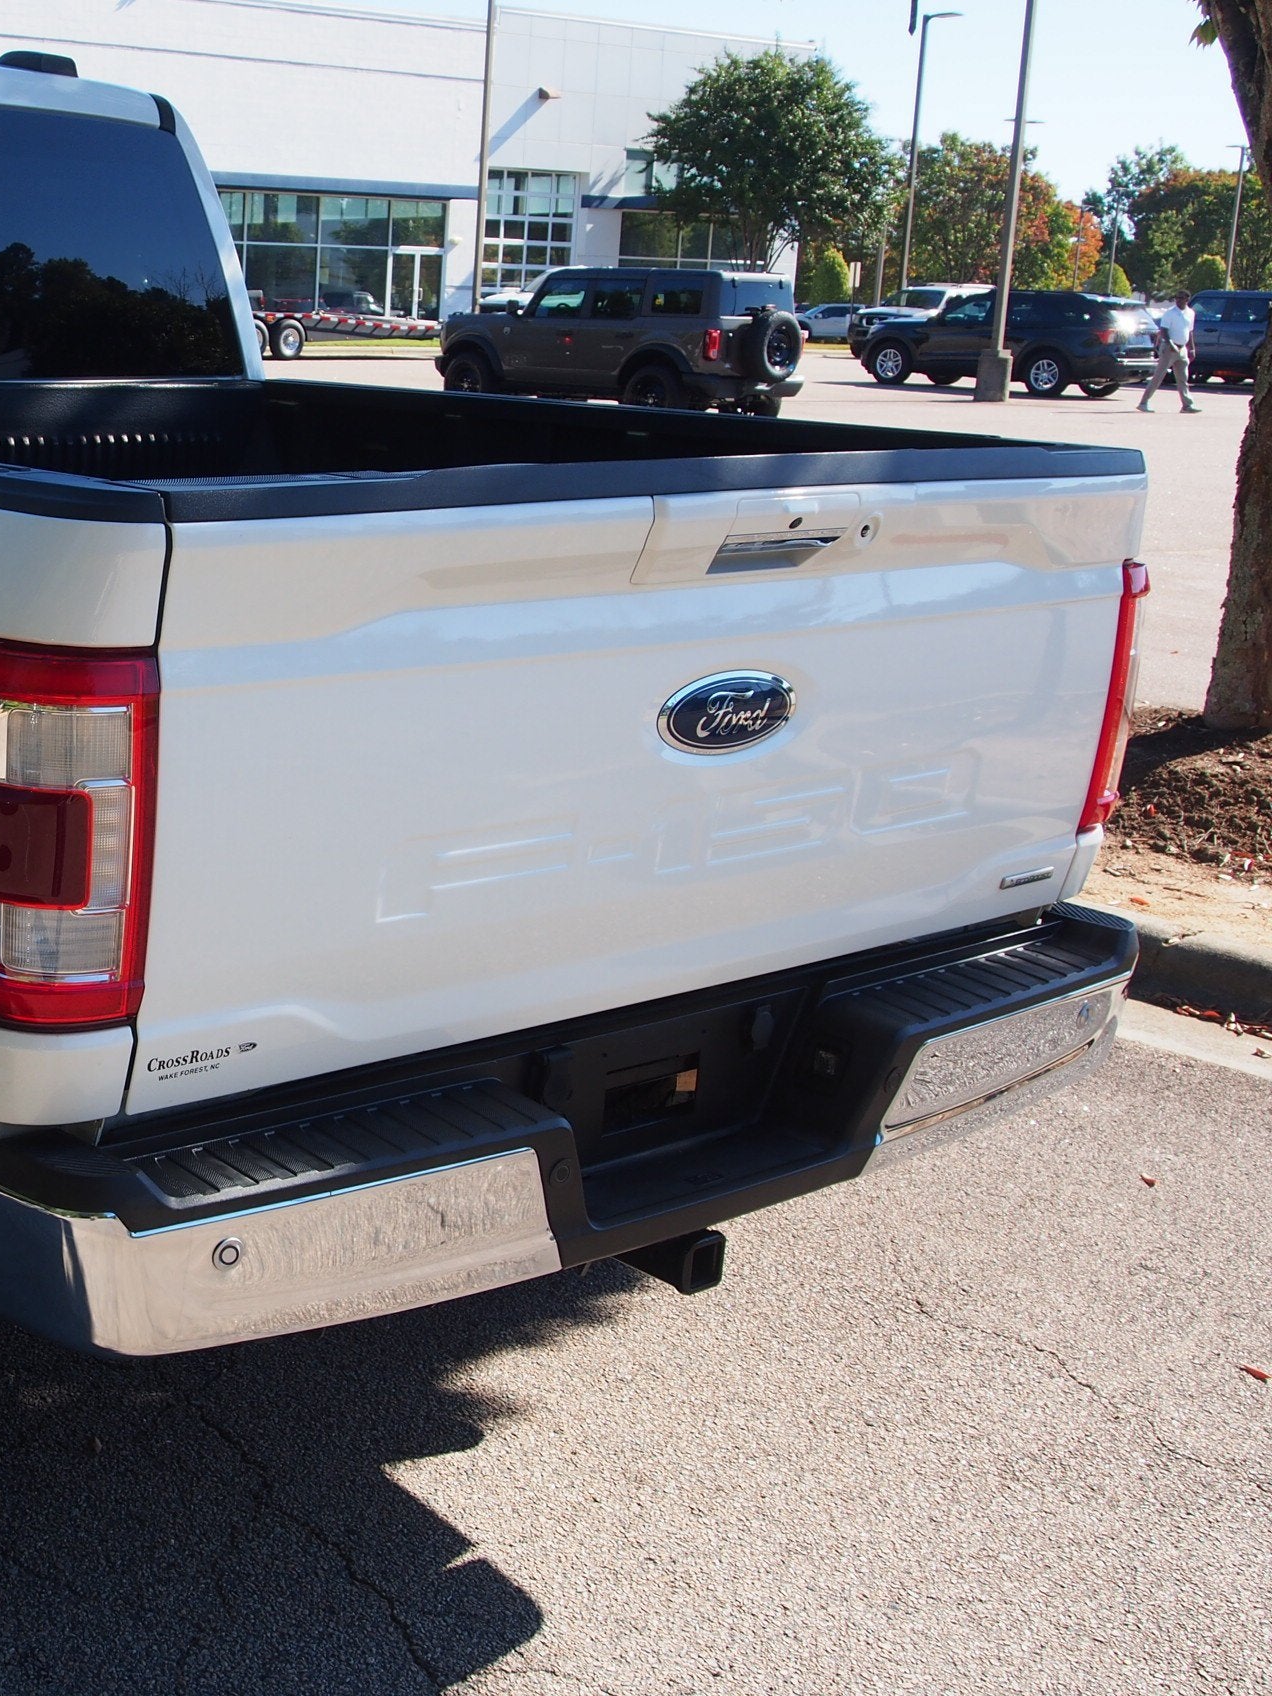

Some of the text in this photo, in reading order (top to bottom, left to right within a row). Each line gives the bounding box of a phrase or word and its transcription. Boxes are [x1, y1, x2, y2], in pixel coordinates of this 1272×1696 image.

[696, 690, 771, 738] Ford
[158, 1062, 220, 1082] WAKE FOREST, NC
